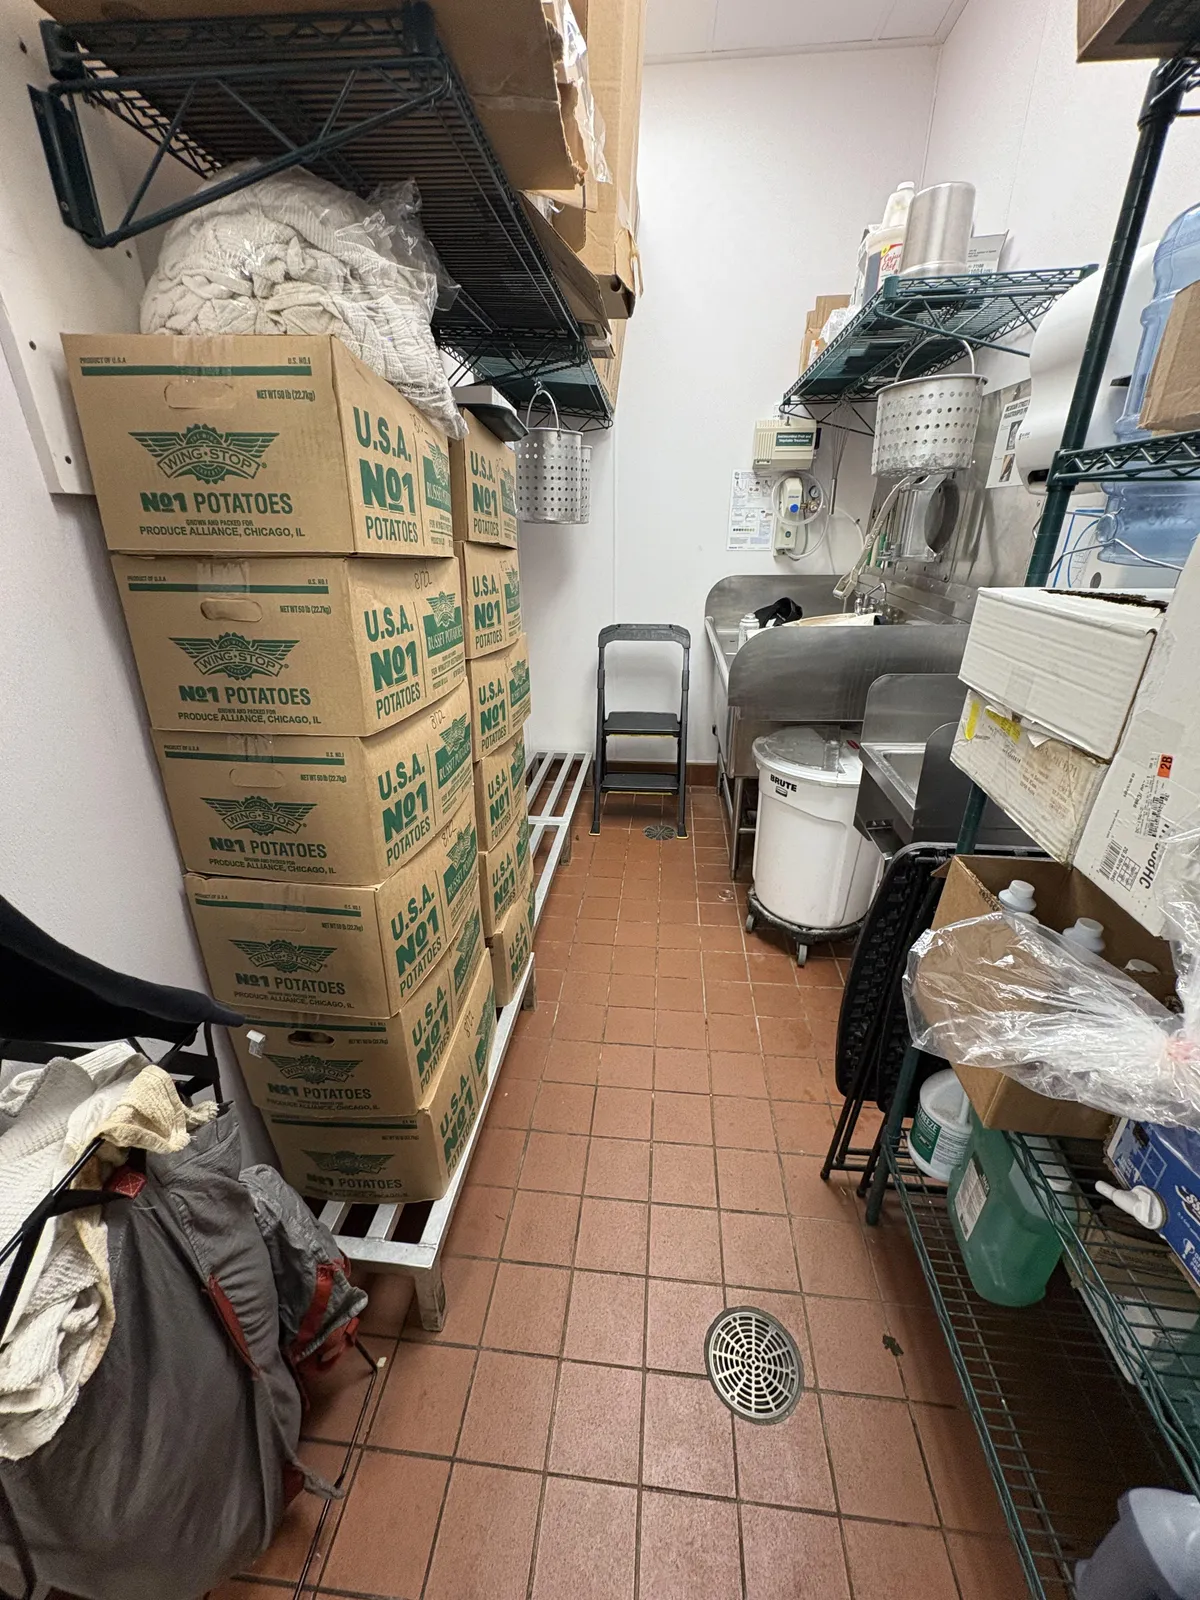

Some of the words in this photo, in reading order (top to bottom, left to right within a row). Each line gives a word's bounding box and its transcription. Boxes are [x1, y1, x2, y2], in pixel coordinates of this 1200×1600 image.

[353, 406, 412, 463] U.S.A.
[470, 450, 495, 483] U.S.A.
[193, 492, 293, 514] POTATOES
[140, 526, 187, 536] PRODUCE
[190, 526, 242, 538] ALLIANCE,
[244, 527, 293, 538] CHICAGO,
[296, 528, 305, 537] IL
[365, 515, 418, 543] POTATOES
[474, 518, 499, 536] POTATOES
[472, 574, 500, 598] U.S.A.
[364, 605, 414, 642] U.S.A.
[476, 629, 502, 650] POTATOES
[224, 686, 311, 705] POTATOES
[376, 682, 421, 720] POTATOES
[479, 678, 504, 705] U.S.A.
[178, 712, 219, 722] PRODUCE
[221, 714, 266, 724] ALLIANCE,
[268, 715, 311, 725] CHICAGO,
[482, 725, 507, 752] POTATOES
[378, 753, 426, 801] U.S.A.
[770, 774, 798, 792] BRUTE
[250, 840, 327, 859] POTATOES
[386, 816, 431, 867] POTATOES
[209, 858, 245, 868] PRODUCE
[247, 862, 287, 872] ALLIANCE,
[288, 865, 327, 874] CHICAGO,
[492, 853, 513, 888] U.S.A.
[391, 883, 435, 941] U.S.A.
[400, 936, 442, 998] POTATOES
[234, 991, 268, 999] PRODUCE
[309, 1000, 346, 1008] CHICAGO,
[275, 977, 346, 995] POTATOES
[412, 985, 447, 1047] U.S.A.
[420, 1026, 450, 1094] POTATOES
[303, 1087, 372, 1099] POTATOES
[440, 1074, 470, 1139] U.S.A.
[339, 1178, 402, 1189] POTATOES
